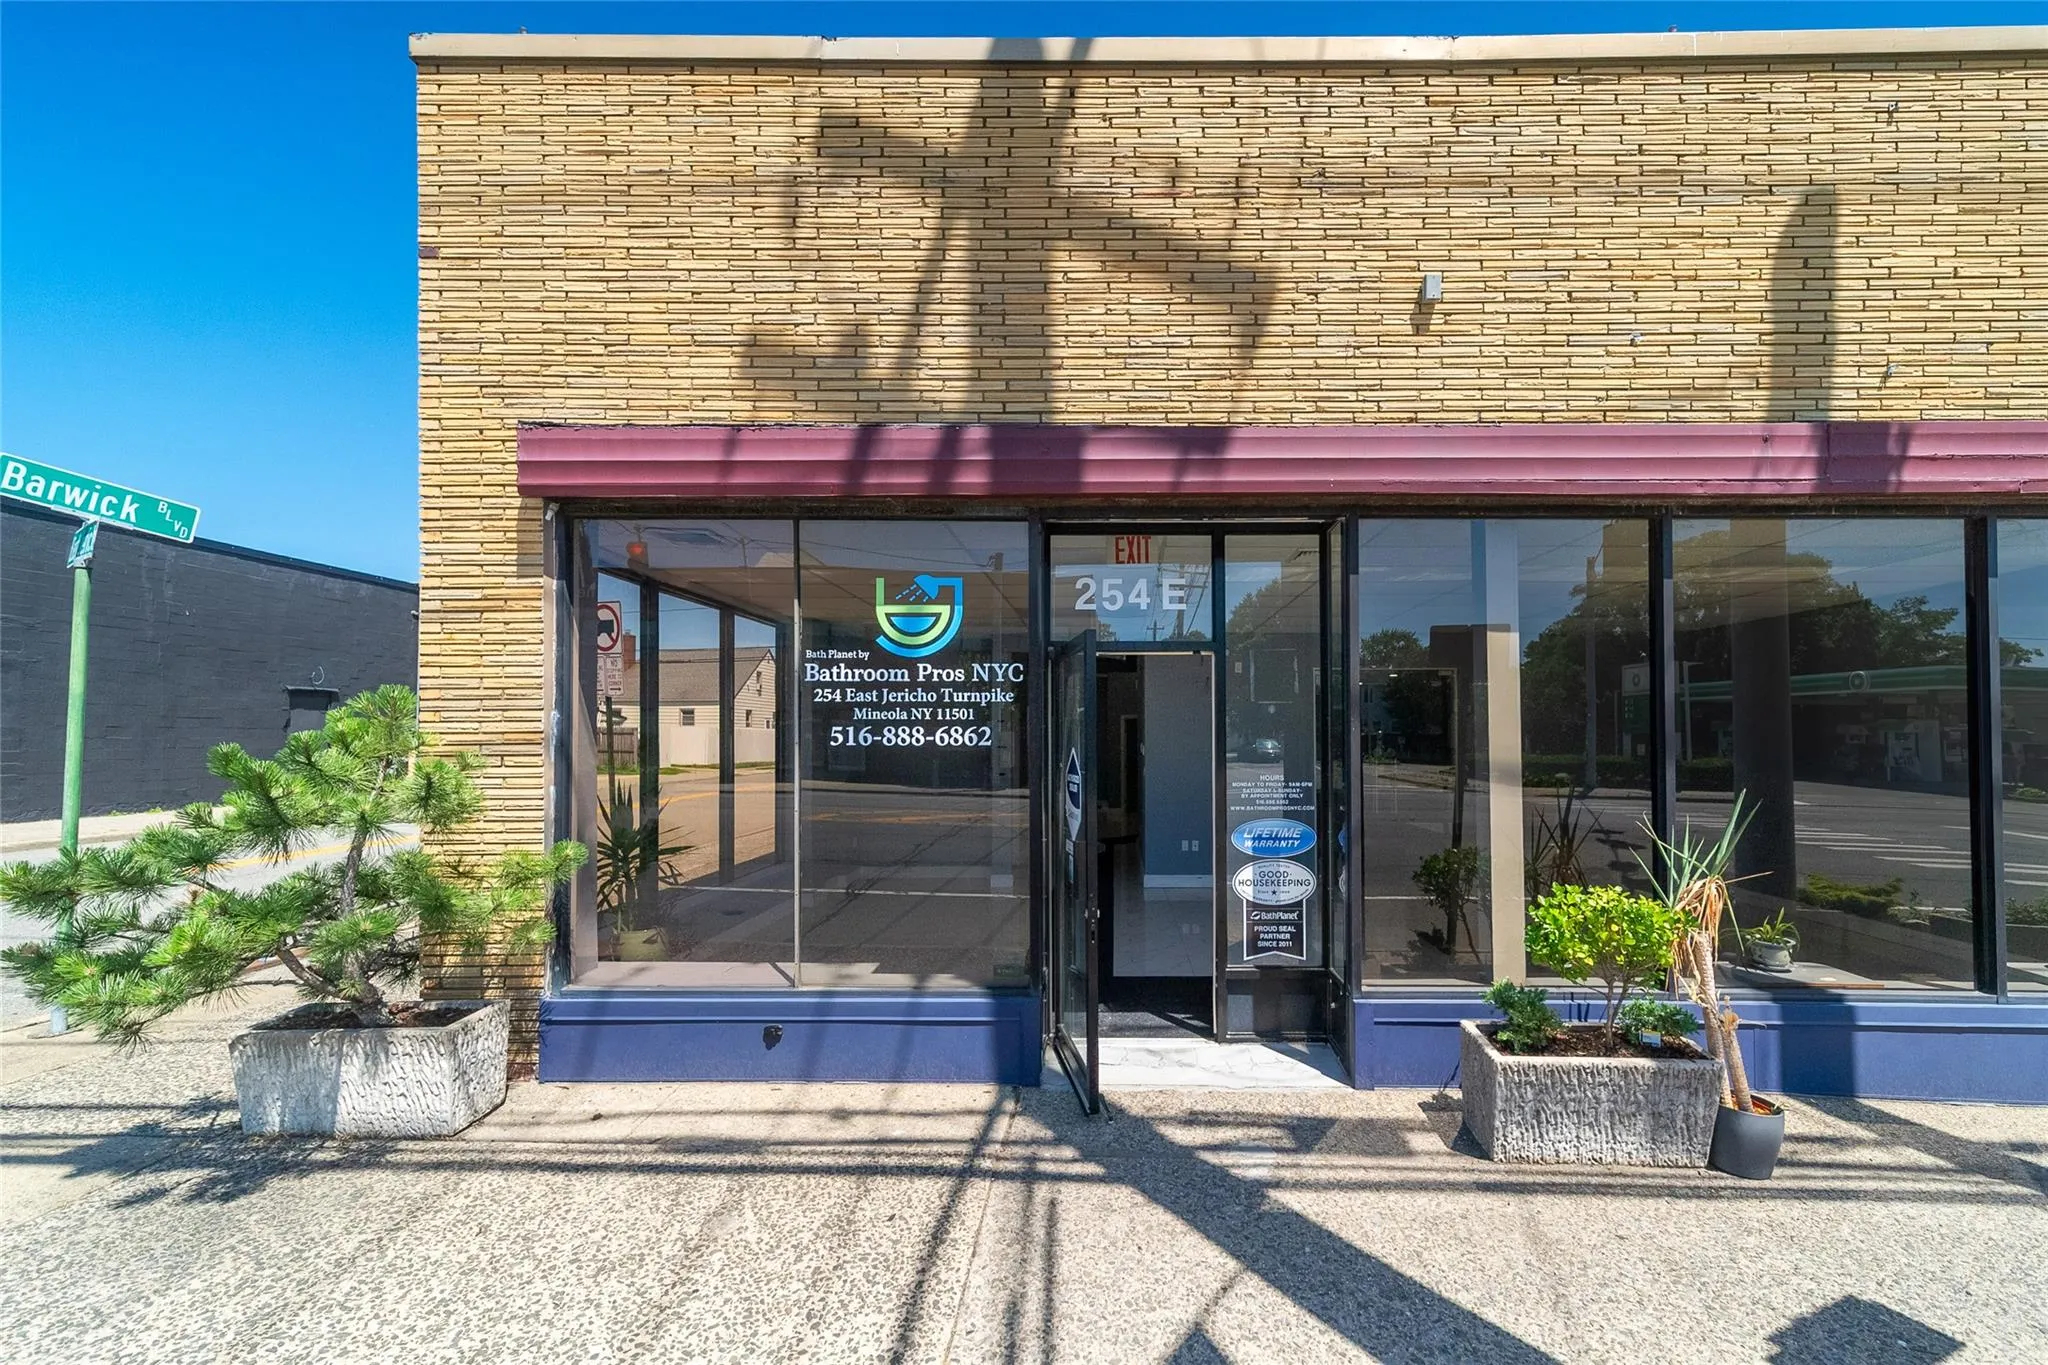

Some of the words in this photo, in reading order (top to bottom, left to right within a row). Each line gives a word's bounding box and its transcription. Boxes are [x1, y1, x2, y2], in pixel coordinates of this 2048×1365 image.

[1, 460, 140, 523] Barwick
[158, 501, 189, 539] BLVD
[1114, 536, 1151, 564] EXIT
[1075, 578, 1151, 611] 254
[1162, 578, 1187, 610] E
[805, 650, 827, 659] Bath
[828, 650, 858, 659] Planet
[858, 650, 870, 661] by
[804, 663, 910, 682] Bathroom
[916, 663, 965, 682] Pros
[972, 663, 1024, 682] NYC
[813, 688, 842, 702] 254
[845, 688, 878, 702] East
[881, 687, 937, 705] Jericho
[941, 687, 1014, 706] Turnpike
[853, 708, 908, 720] Mineola
[911, 708, 933, 720] NY
[937, 708, 975, 720] 11501
[830, 726, 992, 746] 516-888-6862
[1243, 827, 1303, 838] LIFETIME
[1243, 839, 1301, 848] WARRANTY
[1258, 870, 1289, 879] GOOD
[1238, 879, 1311, 887] HOUSEKEEPING
[1261, 911, 1298, 920] BathPlanet
